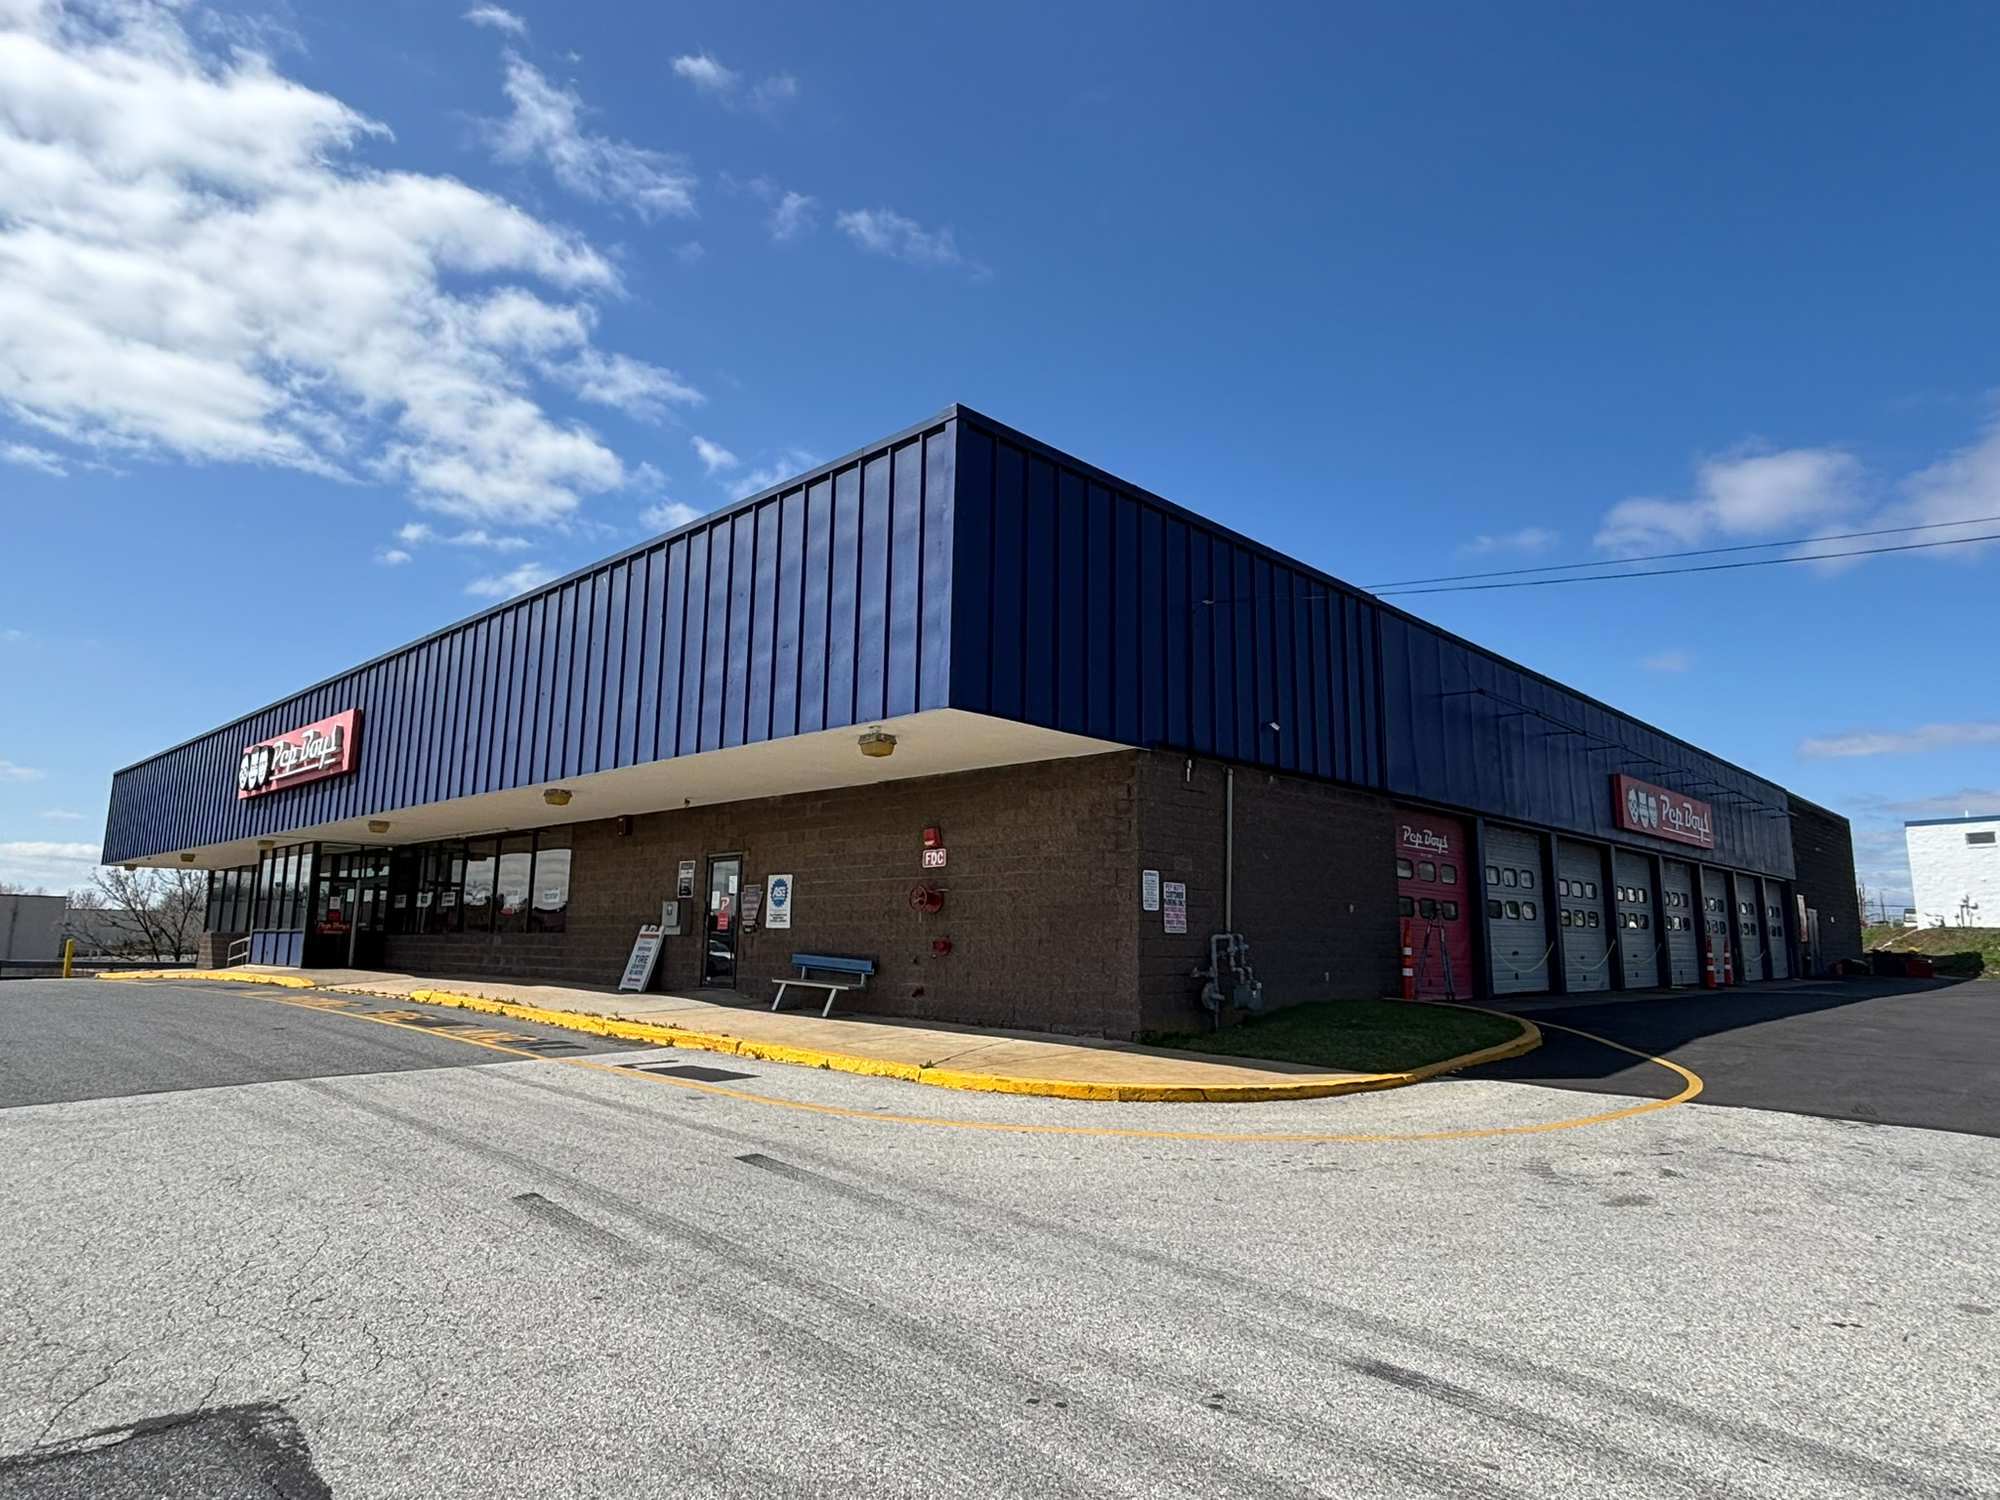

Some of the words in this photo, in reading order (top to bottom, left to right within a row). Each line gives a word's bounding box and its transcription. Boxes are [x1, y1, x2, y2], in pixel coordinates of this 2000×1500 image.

[271, 740, 299, 772] Pep
[300, 725, 337, 770] Boys
[1660, 794, 1683, 830] Pep
[1682, 802, 1710, 842] Boys
[925, 851, 944, 865] FDC
[1402, 825, 1423, 848] Pep
[1423, 829, 1448, 854] Boys
